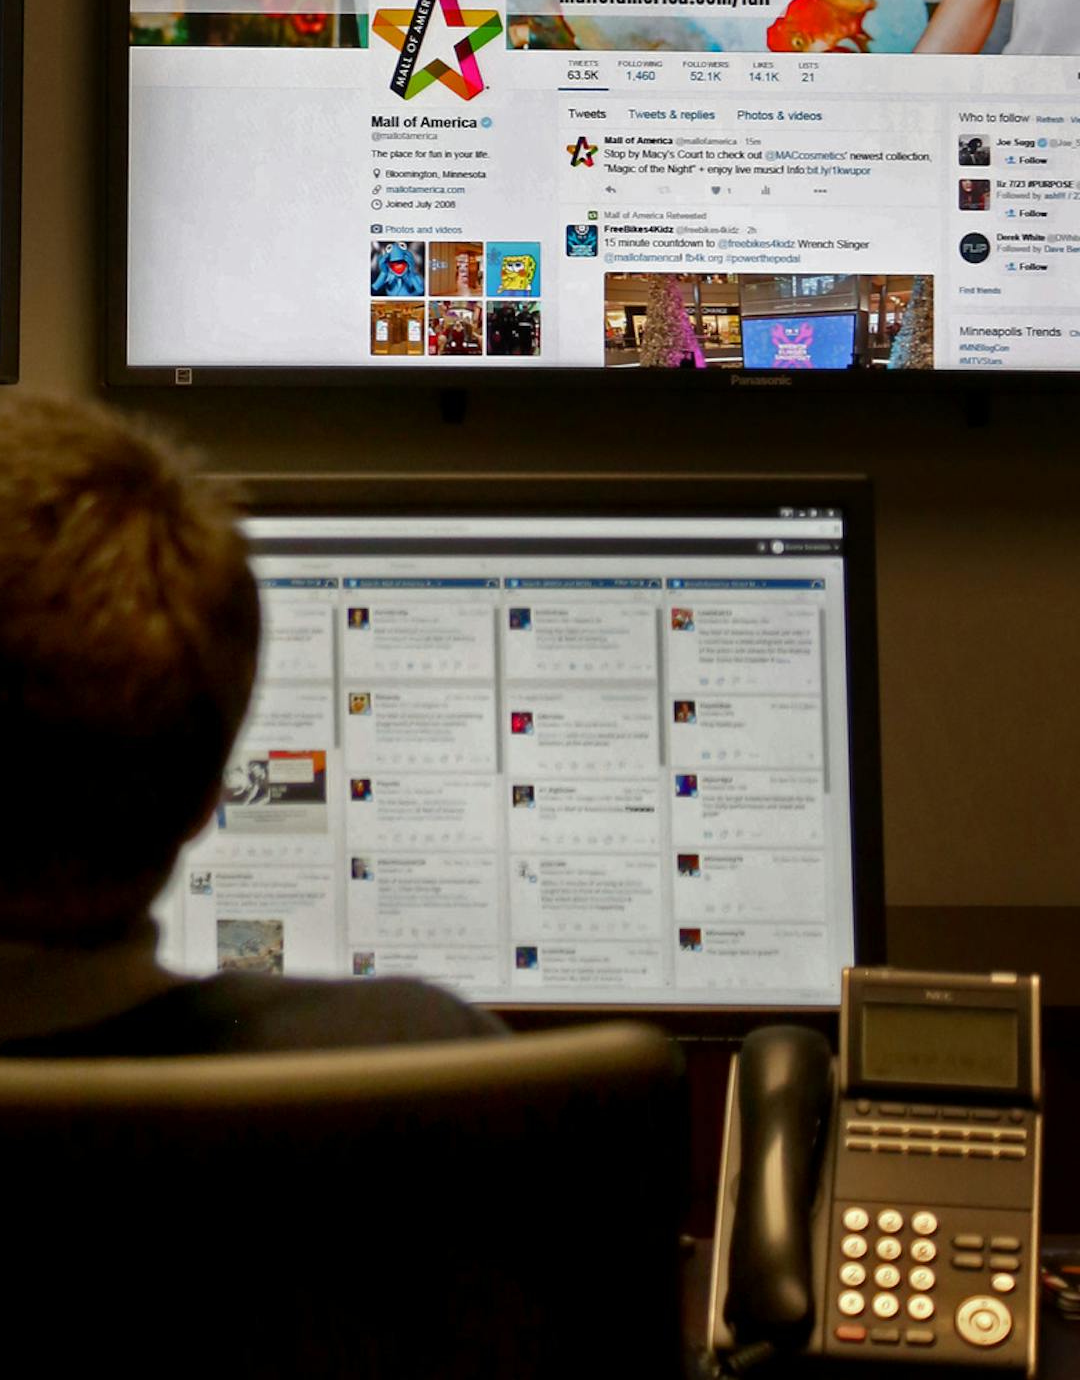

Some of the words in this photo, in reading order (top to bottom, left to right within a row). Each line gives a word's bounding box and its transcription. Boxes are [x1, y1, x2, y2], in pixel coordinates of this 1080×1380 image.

[396, 57, 413, 87] MALL
[406, 35, 418, 54] OF
[568, 70, 598, 80] 63.5K
[627, 70, 655, 82] 1,460
[690, 71, 721, 81] 52.1K
[750, 73, 779, 81] 14.1K
[802, 72, 814, 82] 21
[568, 109, 606, 119] Tweets
[629, 110, 666, 119] Tweets
[669, 110, 677, 119] &
[681, 110, 715, 122] replies
[737, 111, 774, 120] Photos
[777, 111, 784, 120] &
[788, 111, 822, 121] videos
[959, 113, 983, 122] Who
[986, 113, 996, 123] to
[999, 113, 1030, 123] follow
[372, 116, 399, 128] Mall
[404, 117, 417, 128] of
[421, 116, 477, 128] America
[372, 150, 388, 158] The
[390, 151, 413, 159] place
[429, 150, 442, 158] fun
[454, 152, 473, 160] your
[604, 149, 626, 159] Stop
[628, 150, 640, 159] by
[642, 149, 675, 160] Macy's
[677, 150, 703, 159] Court
[706, 151, 715, 159] to
[717, 150, 744, 159] check
[747, 152, 762, 160] out
[850, 153, 883, 161] newest
[885, 152, 932, 161] collection,
[1019, 156, 1047, 164] Follow
[386, 170, 439, 180] Bloomington,
[443, 170, 486, 179] Minnesota
[604, 164, 636, 175] "Magic
[638, 164, 648, 173] of
[650, 165, 665, 173] the
[667, 164, 696, 175] Night"
[707, 167, 732, 176] enjoy
[735, 165, 751, 174] live
[417, 226, 433, 234] and
[435, 226, 462, 234] videos
[604, 225, 673, 233] FreeBikes4Kidz
[960, 327, 1022, 338] Minneapolis
[1026, 326, 1062, 337] Trends
[731, 374, 792, 386] Panasonic
[926, 990, 954, 1001] NEC
